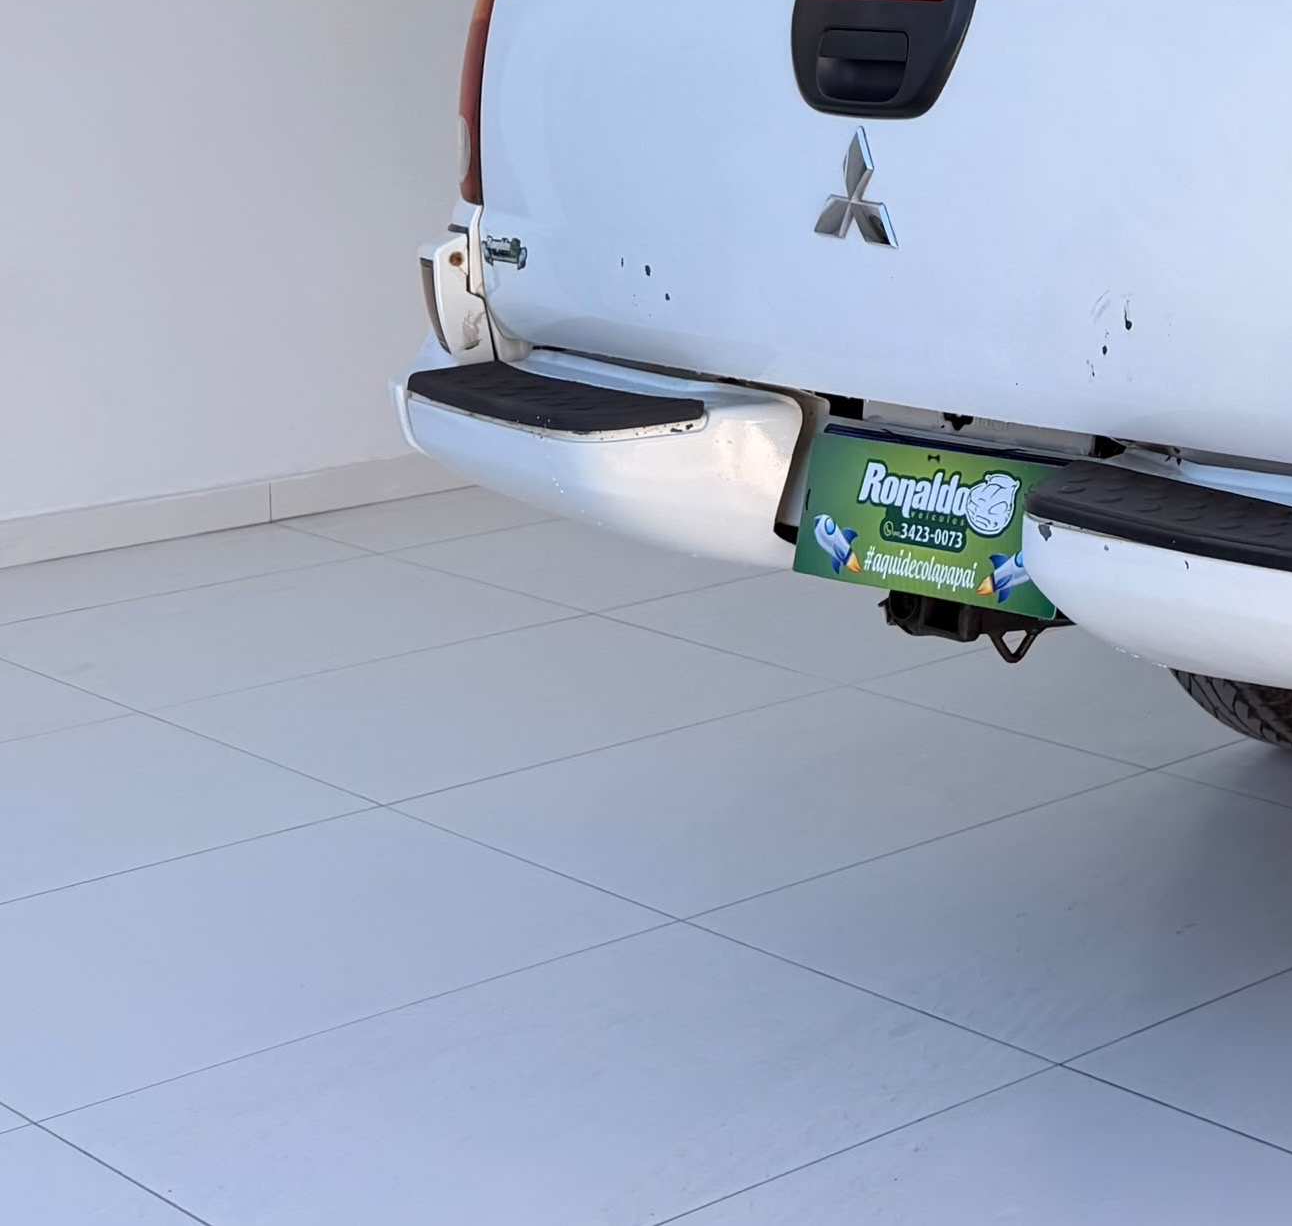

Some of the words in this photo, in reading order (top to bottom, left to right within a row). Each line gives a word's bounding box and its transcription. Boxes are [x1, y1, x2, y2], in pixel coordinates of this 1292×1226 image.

[858, 461, 967, 519] Ronaldo
[900, 522, 963, 549] 3423-0073
[863, 545, 978, 592] #aquidecolapapai
